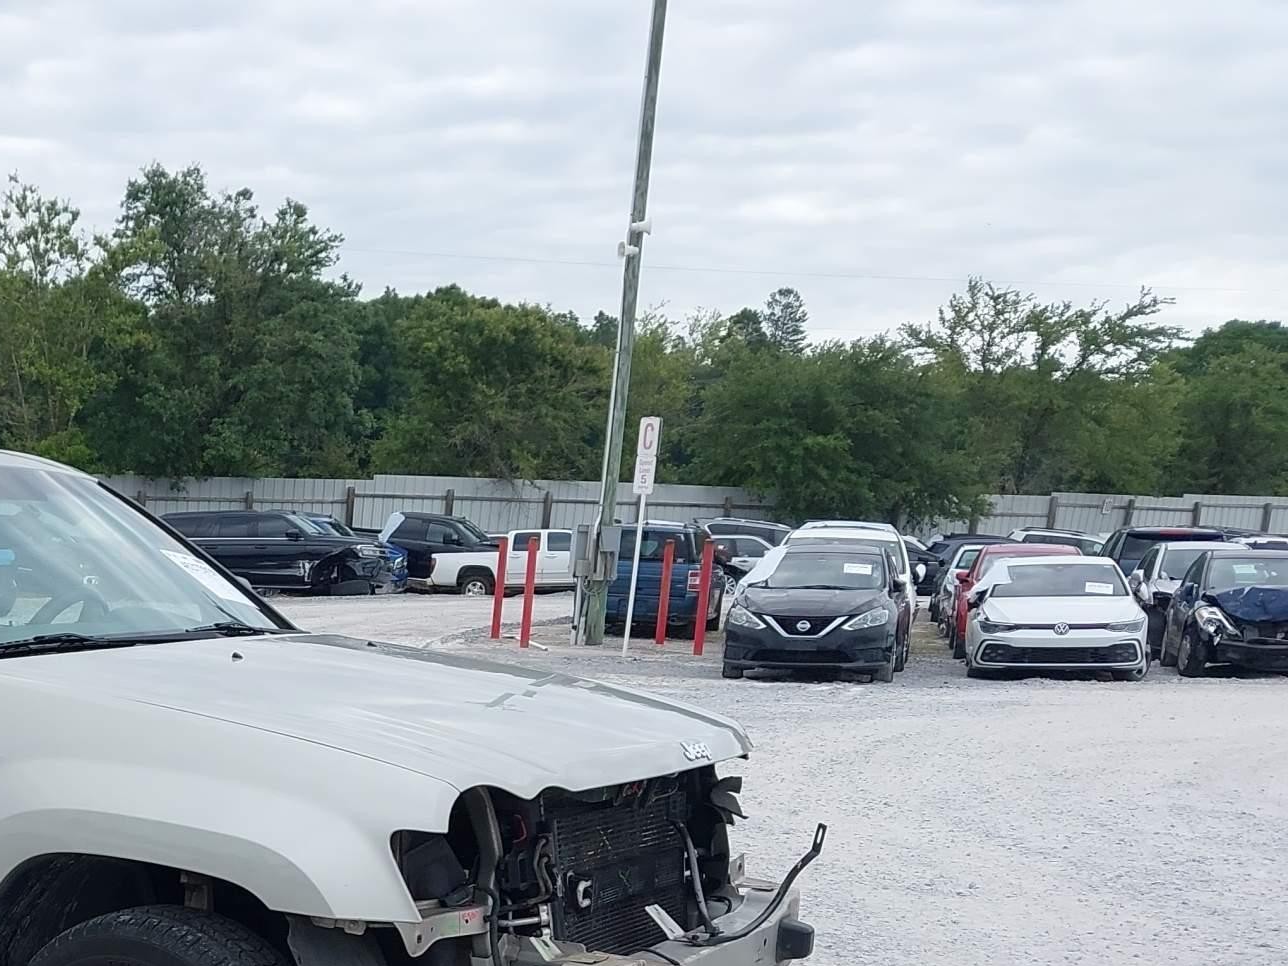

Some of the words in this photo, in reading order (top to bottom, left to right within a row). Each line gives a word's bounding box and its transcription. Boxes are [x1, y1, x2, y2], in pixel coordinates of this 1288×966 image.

[643, 422, 654, 450] C
[640, 474, 647, 484] 5
[680, 741, 713, 761] Jeep
